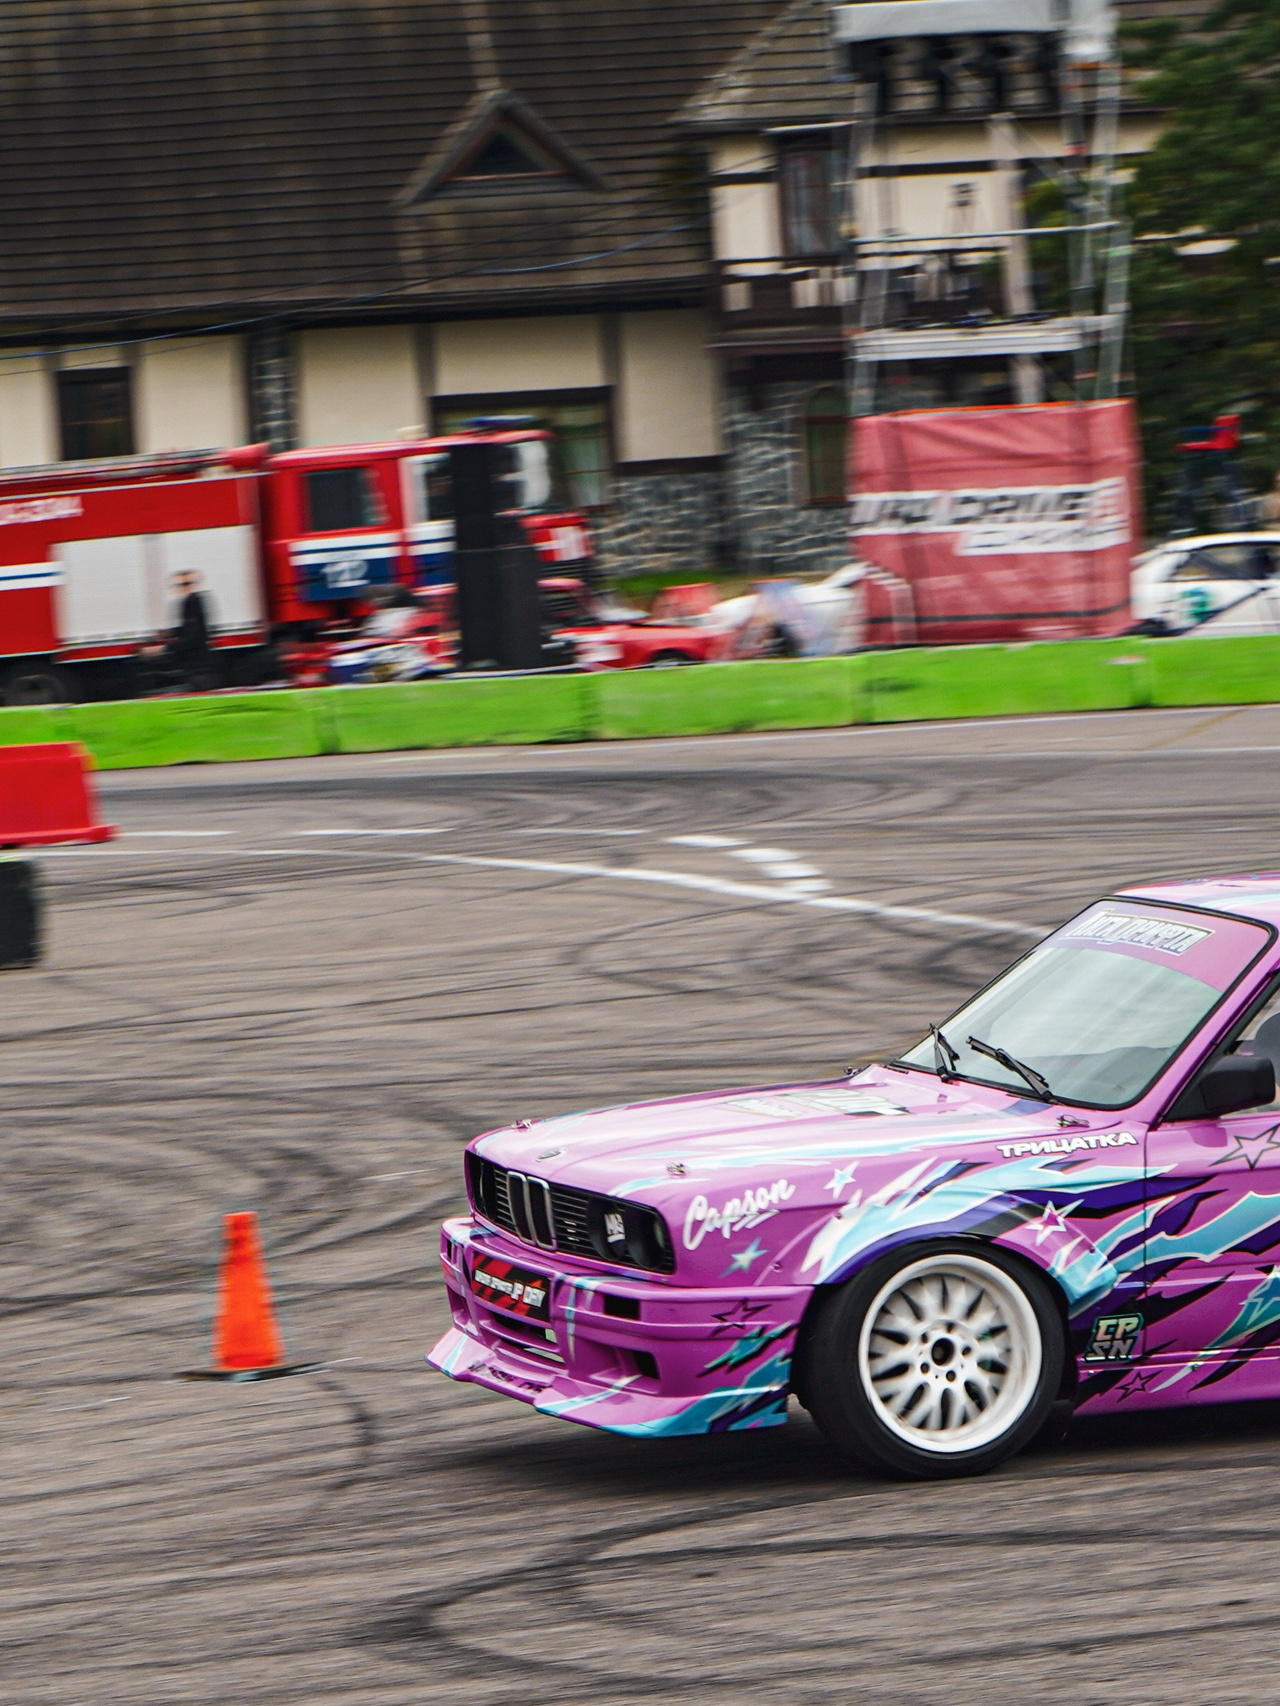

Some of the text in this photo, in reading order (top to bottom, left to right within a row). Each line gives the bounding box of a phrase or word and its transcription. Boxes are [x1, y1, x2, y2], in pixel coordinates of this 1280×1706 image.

[1107, 917, 1209, 953] ДРИФТА
[996, 1131, 1139, 1158] ТРИЦАТКА
[682, 1178, 797, 1251] Capson
